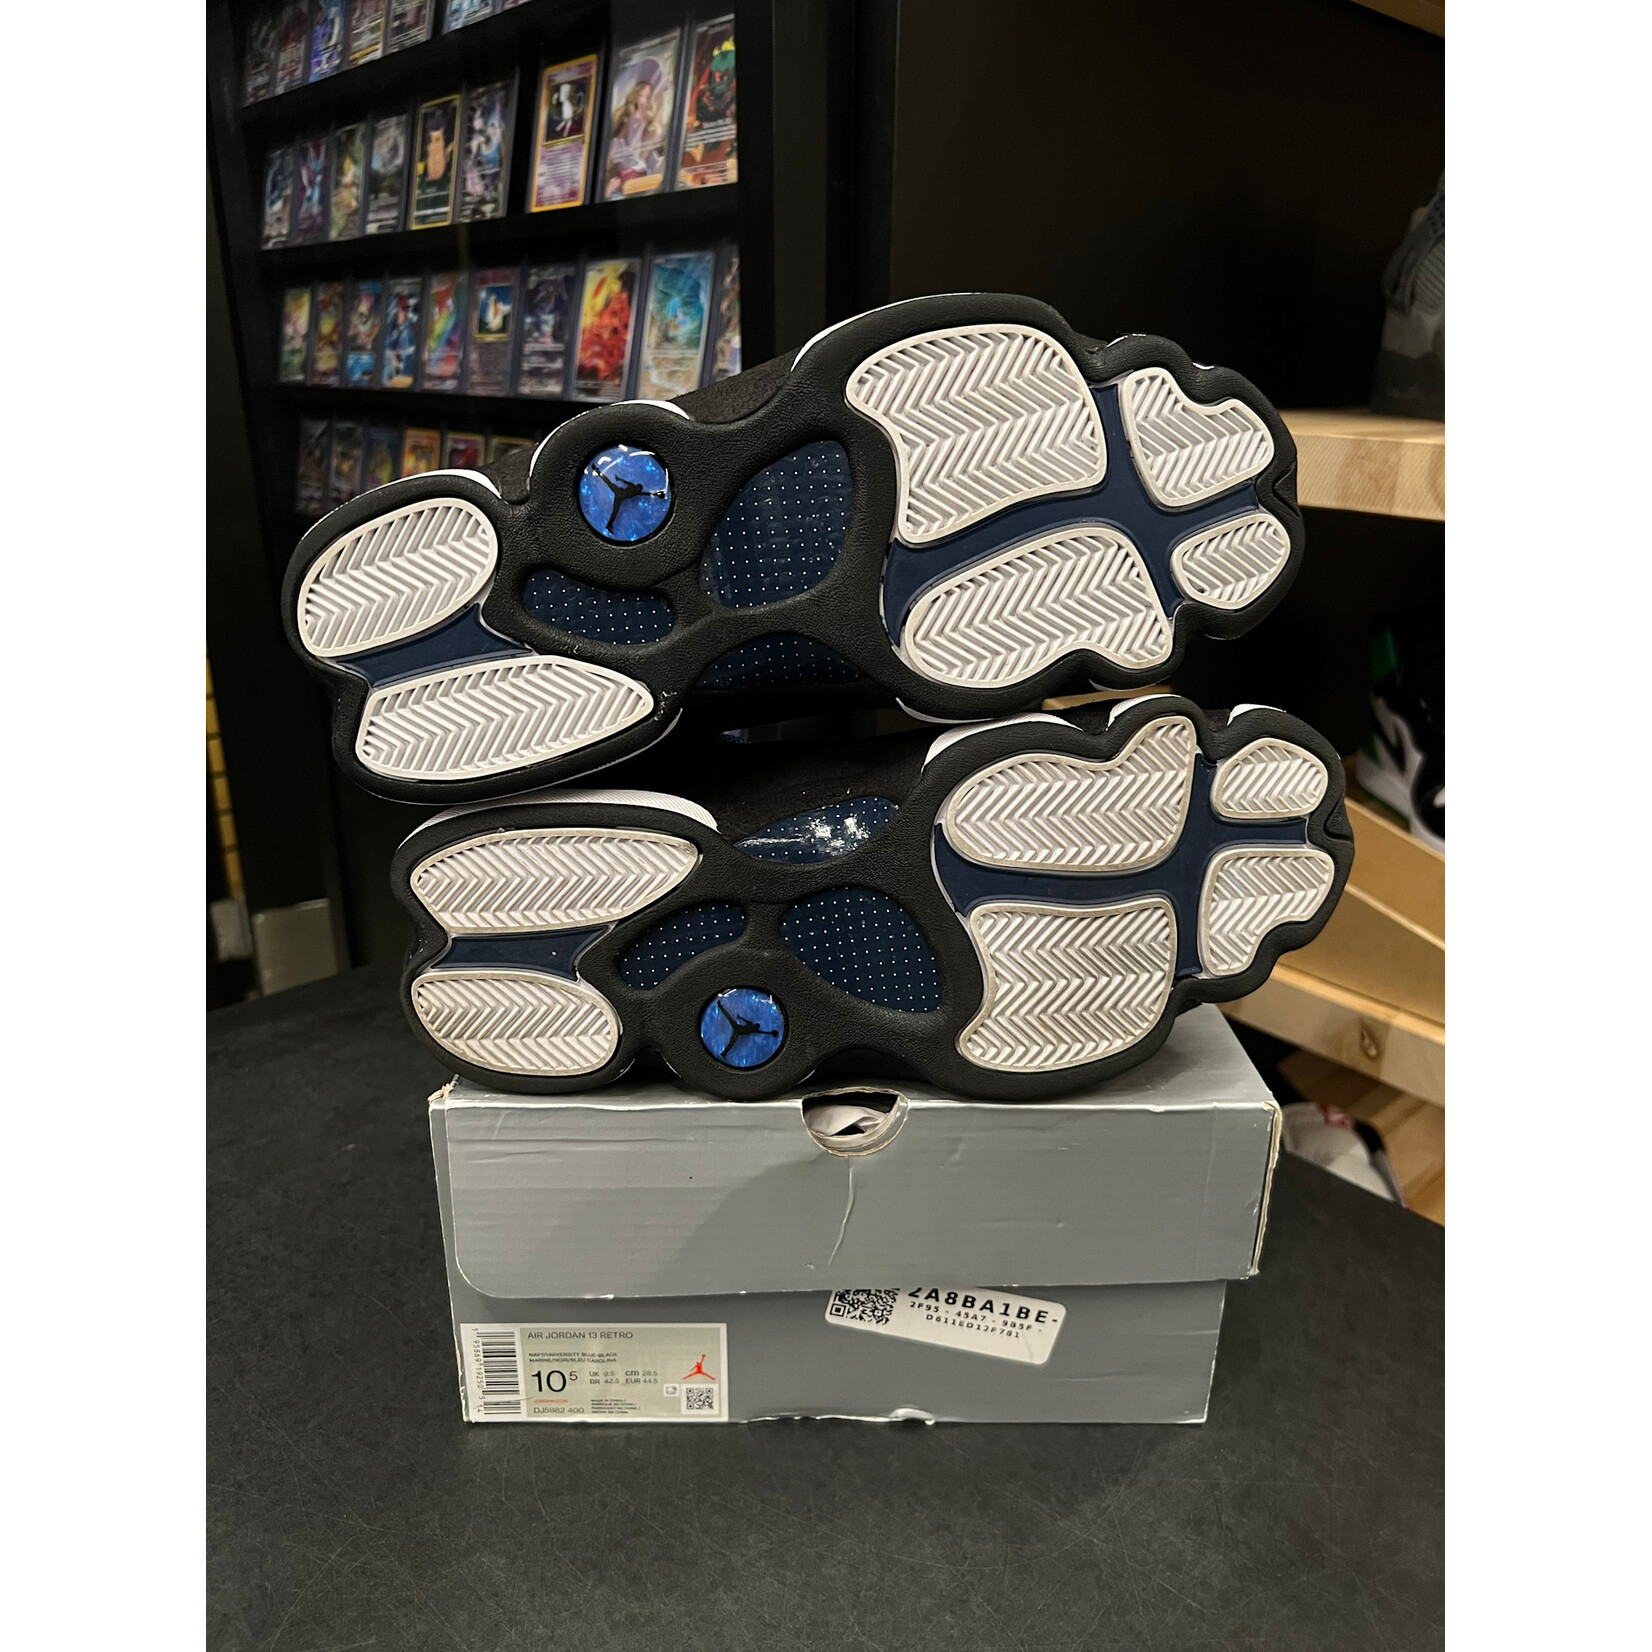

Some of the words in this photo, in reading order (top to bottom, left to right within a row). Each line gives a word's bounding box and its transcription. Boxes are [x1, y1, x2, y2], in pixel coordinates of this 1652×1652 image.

[955, 1310, 986, 1322] 45A7
[527, 1331, 543, 1339] AIR
[545, 1331, 586, 1339] JORDAN
[588, 1331, 598, 1339] 13
[600, 1331, 634, 1339] RETRO
